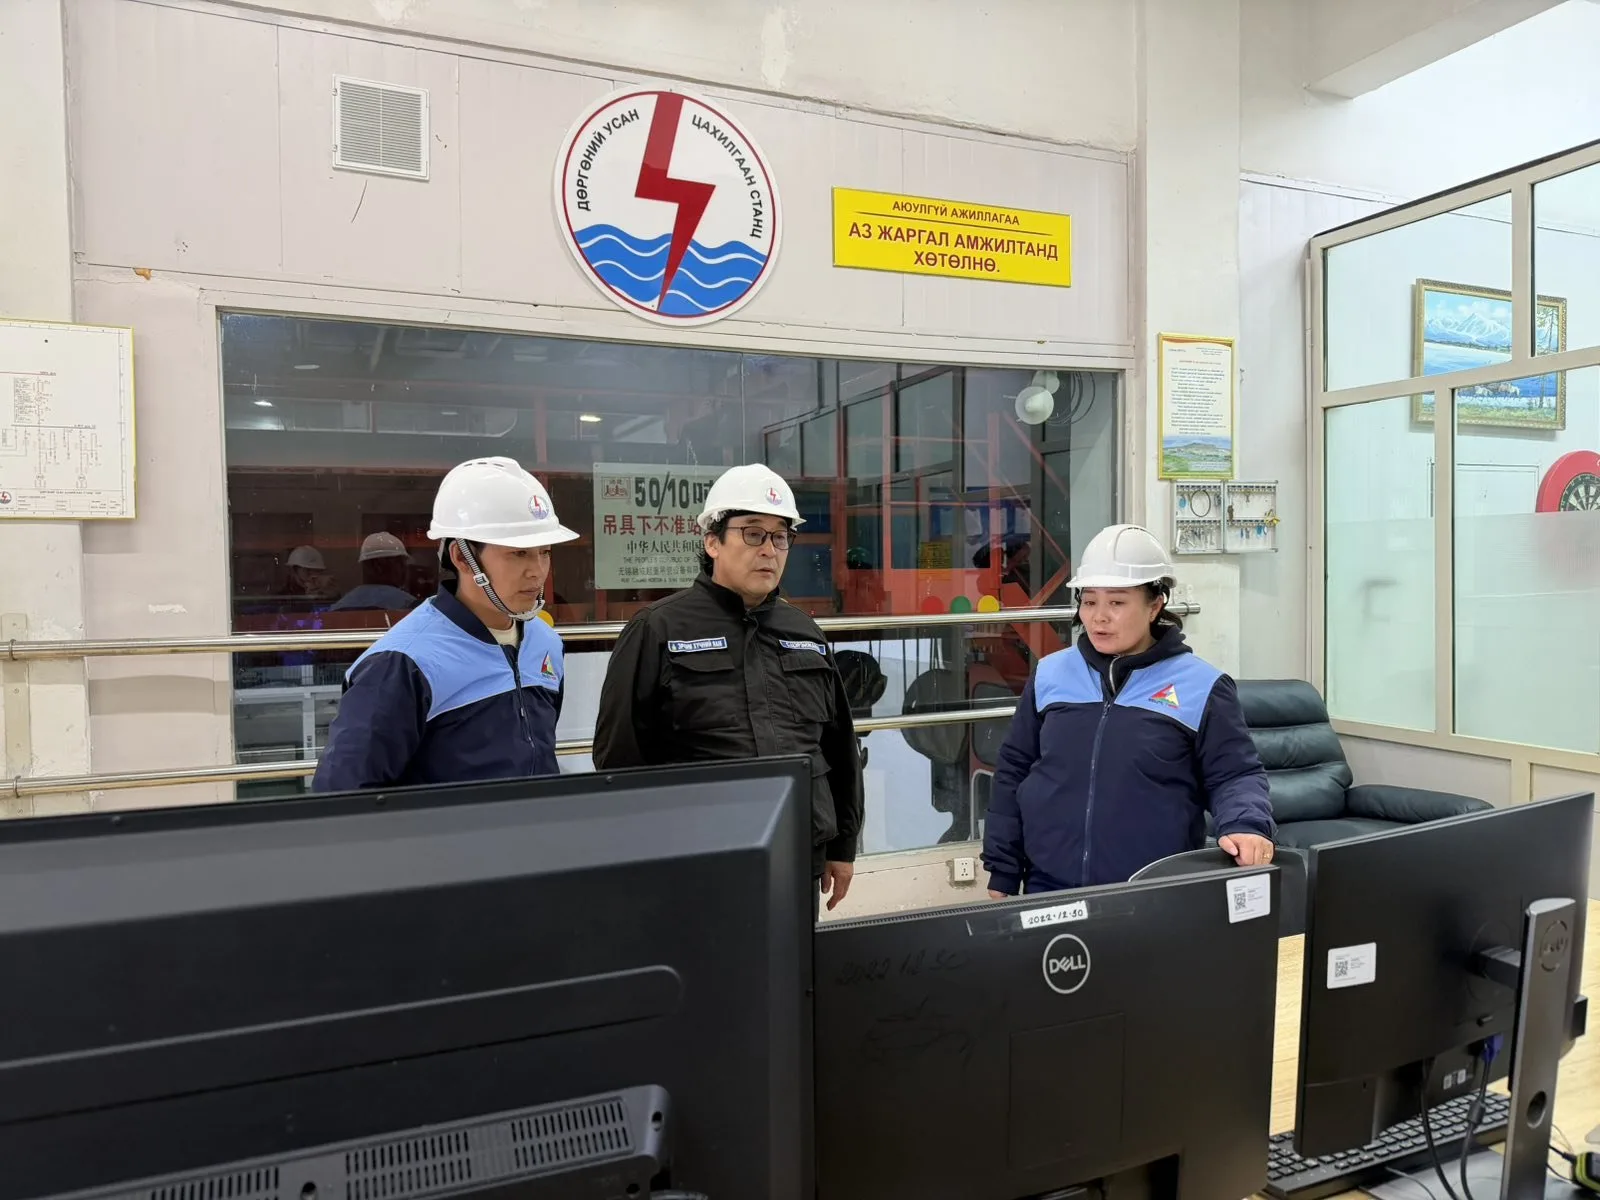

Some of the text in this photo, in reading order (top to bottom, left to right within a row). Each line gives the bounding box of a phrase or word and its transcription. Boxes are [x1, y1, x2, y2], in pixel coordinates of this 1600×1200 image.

[576, 108, 640, 212] ДӨРГӨНИЙ УСАН
[691, 113, 764, 239] ЦАХИЛГААН СТАНЦ
[892, 200, 1020, 226] АЮУЛГҮЙ АЖИЛЛАГАА
[848, 222, 1059, 261] АЗ ЖАРГАЛ АМЖИЛТАНД
[913, 251, 1001, 273] ХӨТӨЛНӨ.
[1048, 954, 1087, 974] DELL
